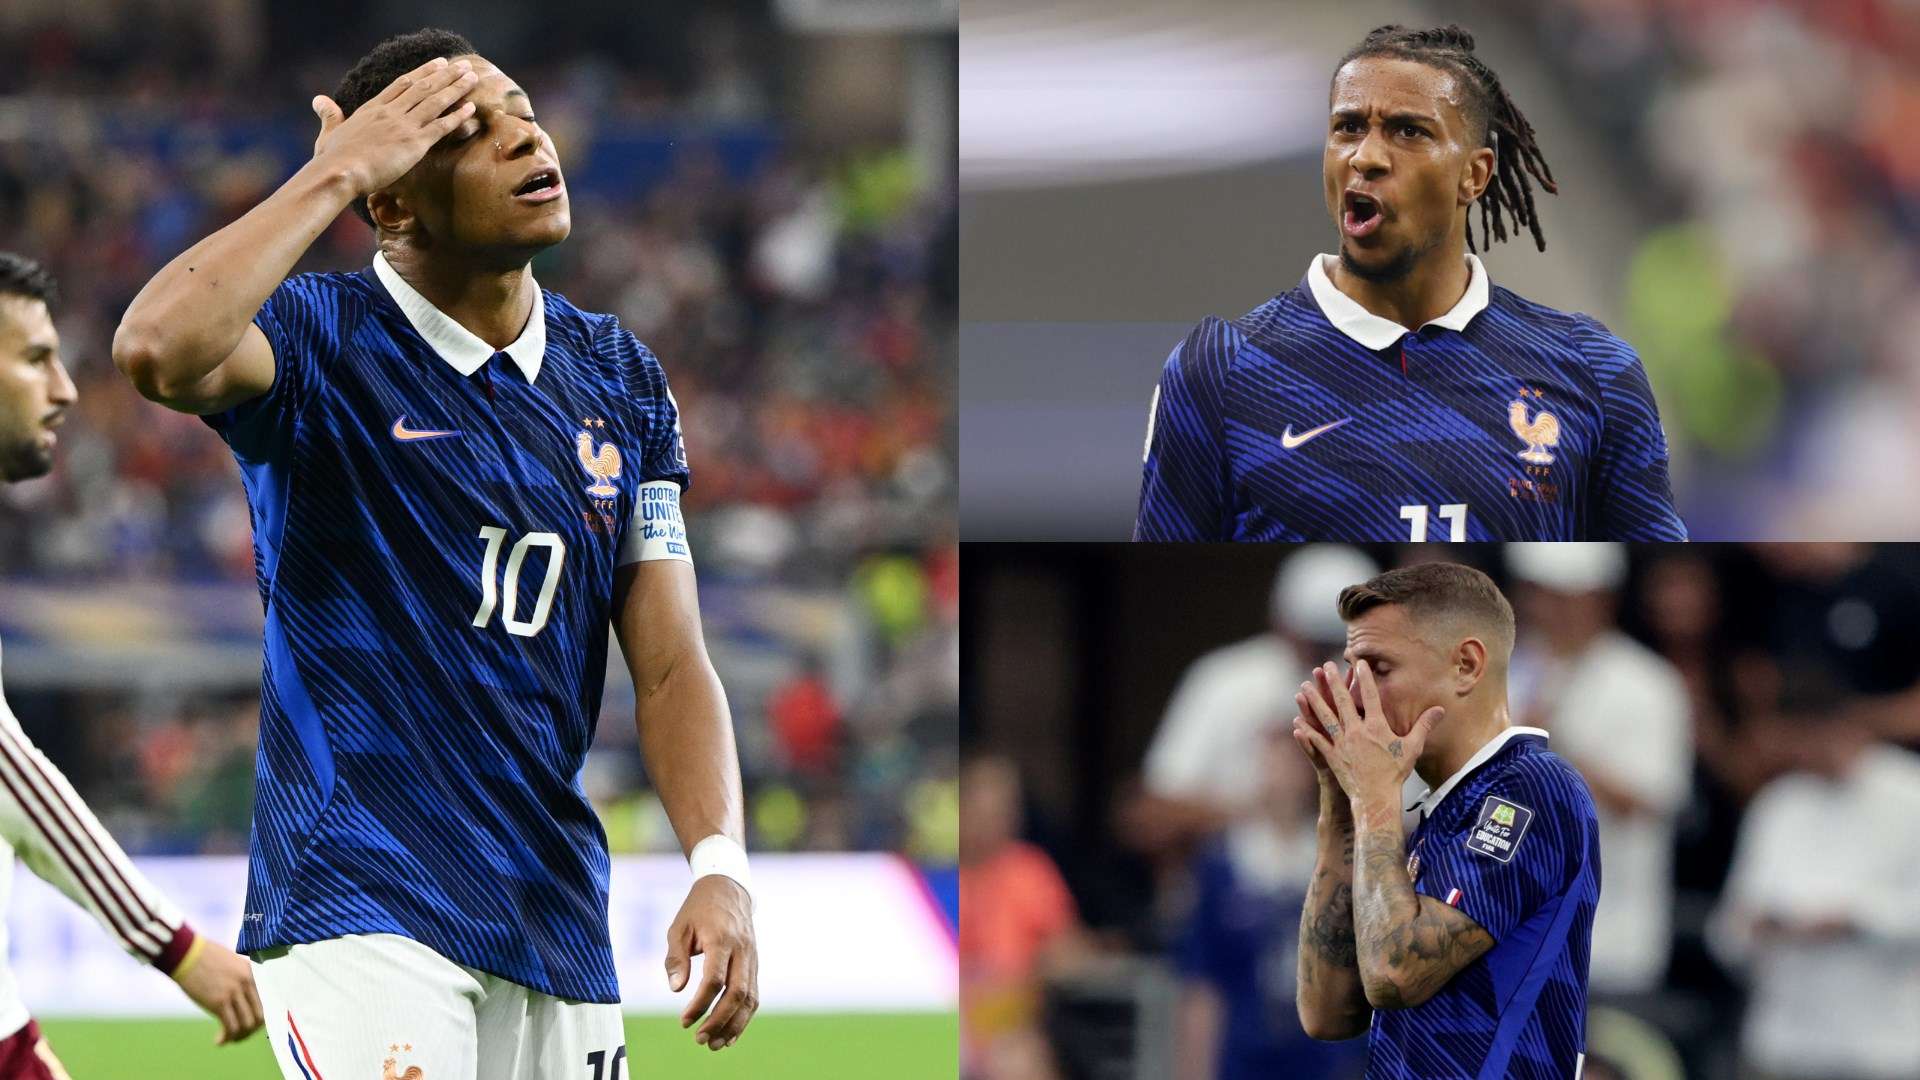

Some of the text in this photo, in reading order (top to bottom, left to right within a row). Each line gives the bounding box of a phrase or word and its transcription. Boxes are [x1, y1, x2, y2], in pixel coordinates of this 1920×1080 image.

[640, 522, 667, 540] the
[472, 525, 566, 637] 10
[1475, 829, 1512, 852] EDUCATION
